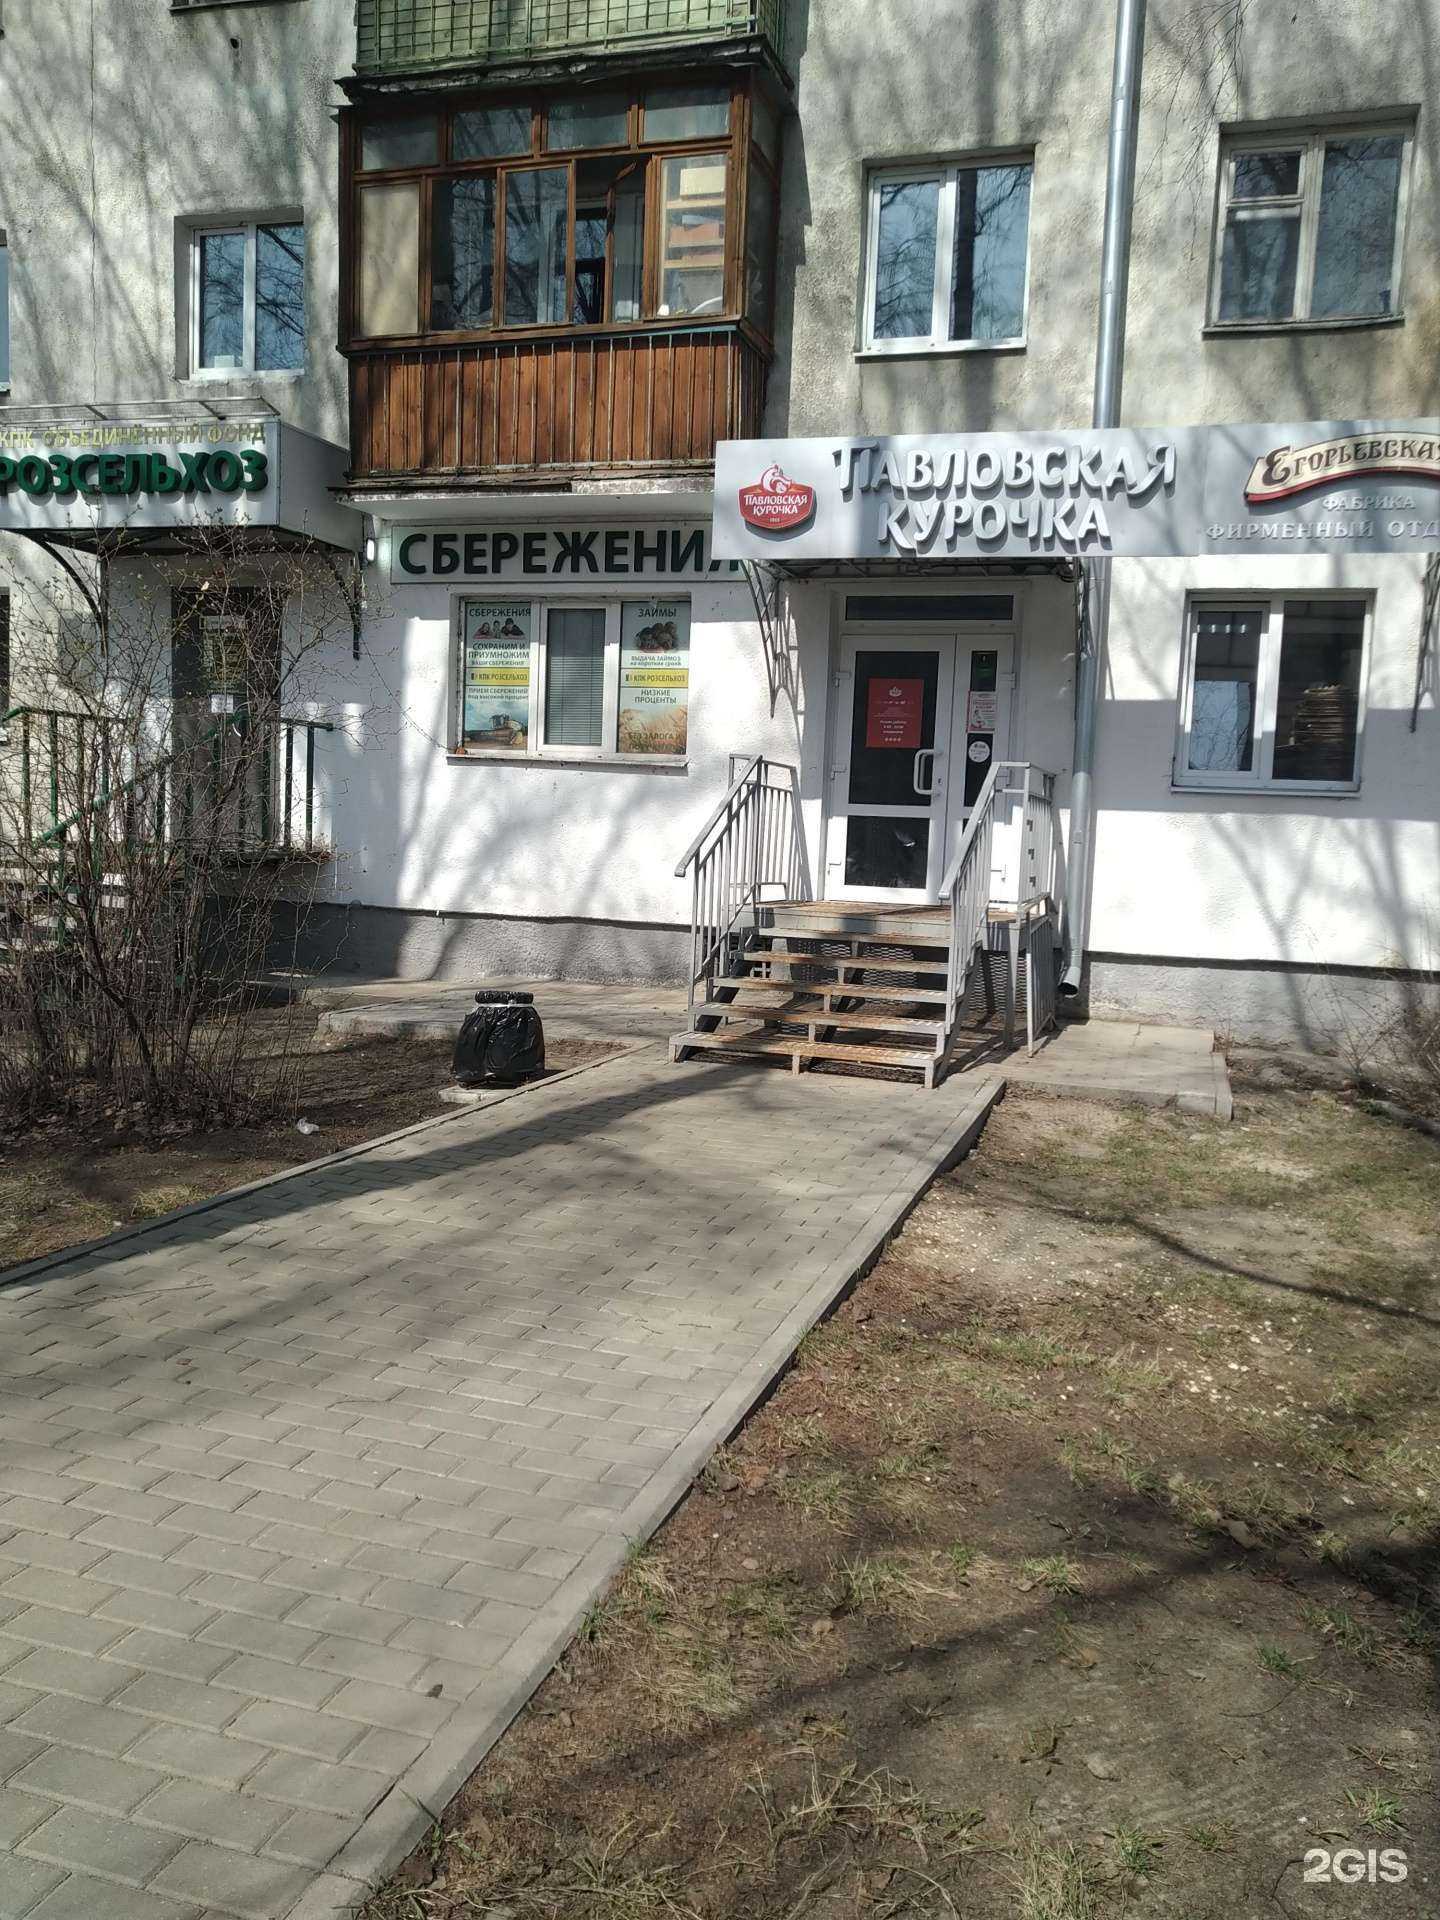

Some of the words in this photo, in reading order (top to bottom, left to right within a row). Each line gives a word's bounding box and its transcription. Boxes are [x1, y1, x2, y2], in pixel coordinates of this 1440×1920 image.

[0, 430, 33, 448] КПК
[43, 423, 202, 448] ОБЪЕДИНЁННЫЙ
[208, 423, 266, 445] ФОНД
[832, 440, 1177, 497] ПАВЛОВСКАЯ
[1261, 440, 1440, 486] ЕГОРЬЕВСКА
[743, 494, 808, 506] ПАВЛОВСКАЯ
[1322, 496, 1416, 512] ФАБРИКА
[753, 505, 798, 516] КУРОЧКА
[878, 497, 1112, 551] КУРОЧКА
[1206, 519, 1374, 540] ФИРМЕННЫЙ
[469, 607, 531, 617] СБЕРЕЖЕНИЯ
[638, 607, 677, 617] ЗАЙМЫ
[472, 642, 518, 650] СОХРАНИМ
[519, 642, 526, 650] И
[468, 650, 530, 659] ПРИУМНОЖИМ
[640, 689, 671, 697] НИЗКИЕ
[634, 696, 677, 705] ПРОЦЕНТЫ
